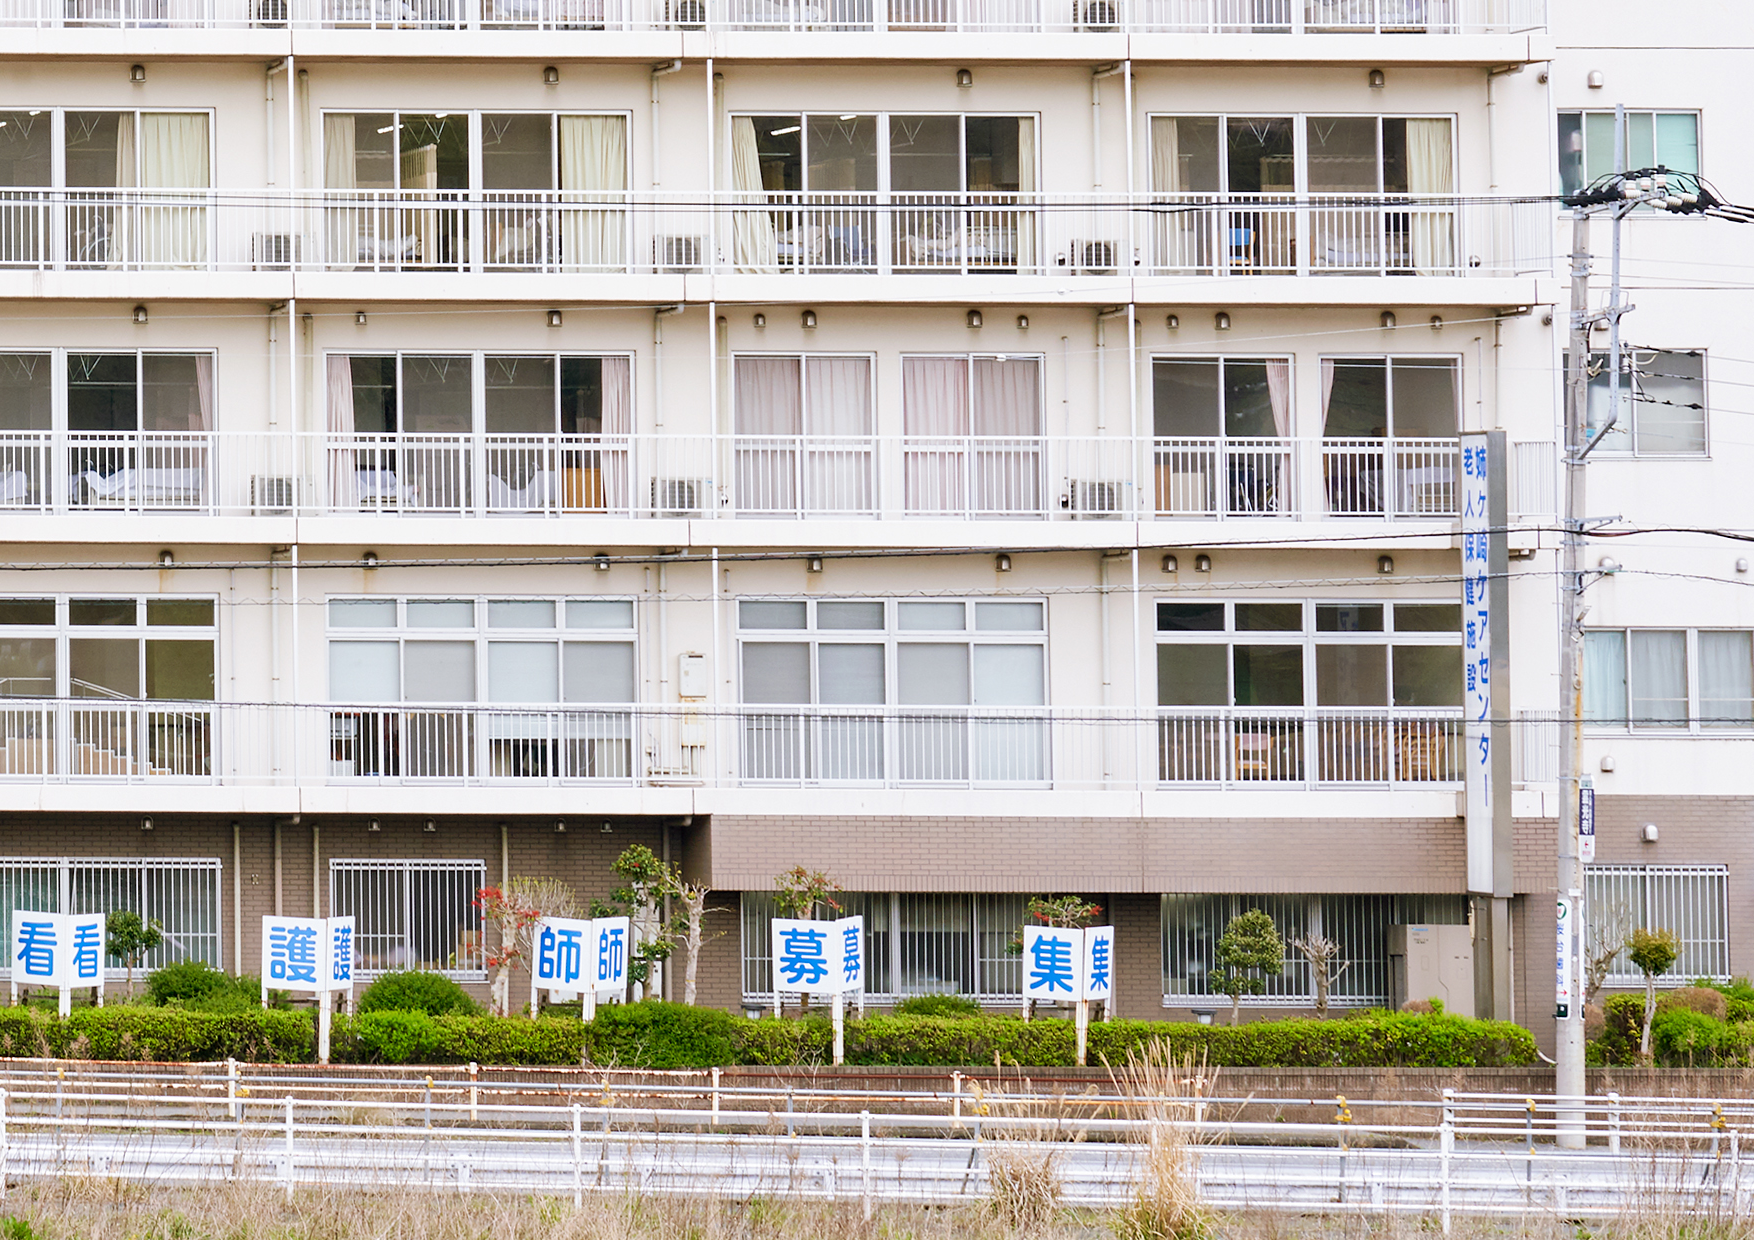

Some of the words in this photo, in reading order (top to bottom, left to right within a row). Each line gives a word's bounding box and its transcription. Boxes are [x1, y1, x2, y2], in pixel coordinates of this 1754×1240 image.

[1463, 446, 1477, 693] 老人保健施設
[17, 921, 58, 977] 看
[72, 923, 101, 979] 看
[269, 926, 318, 984] 護
[332, 924, 352, 982] 護
[538, 927, 583, 984] 師
[598, 928, 624, 983] 師
[779, 927, 829, 985] 募
[842, 926, 862, 983] 募
[1029, 934, 1075, 993] 集
[1090, 935, 1111, 992] 集
